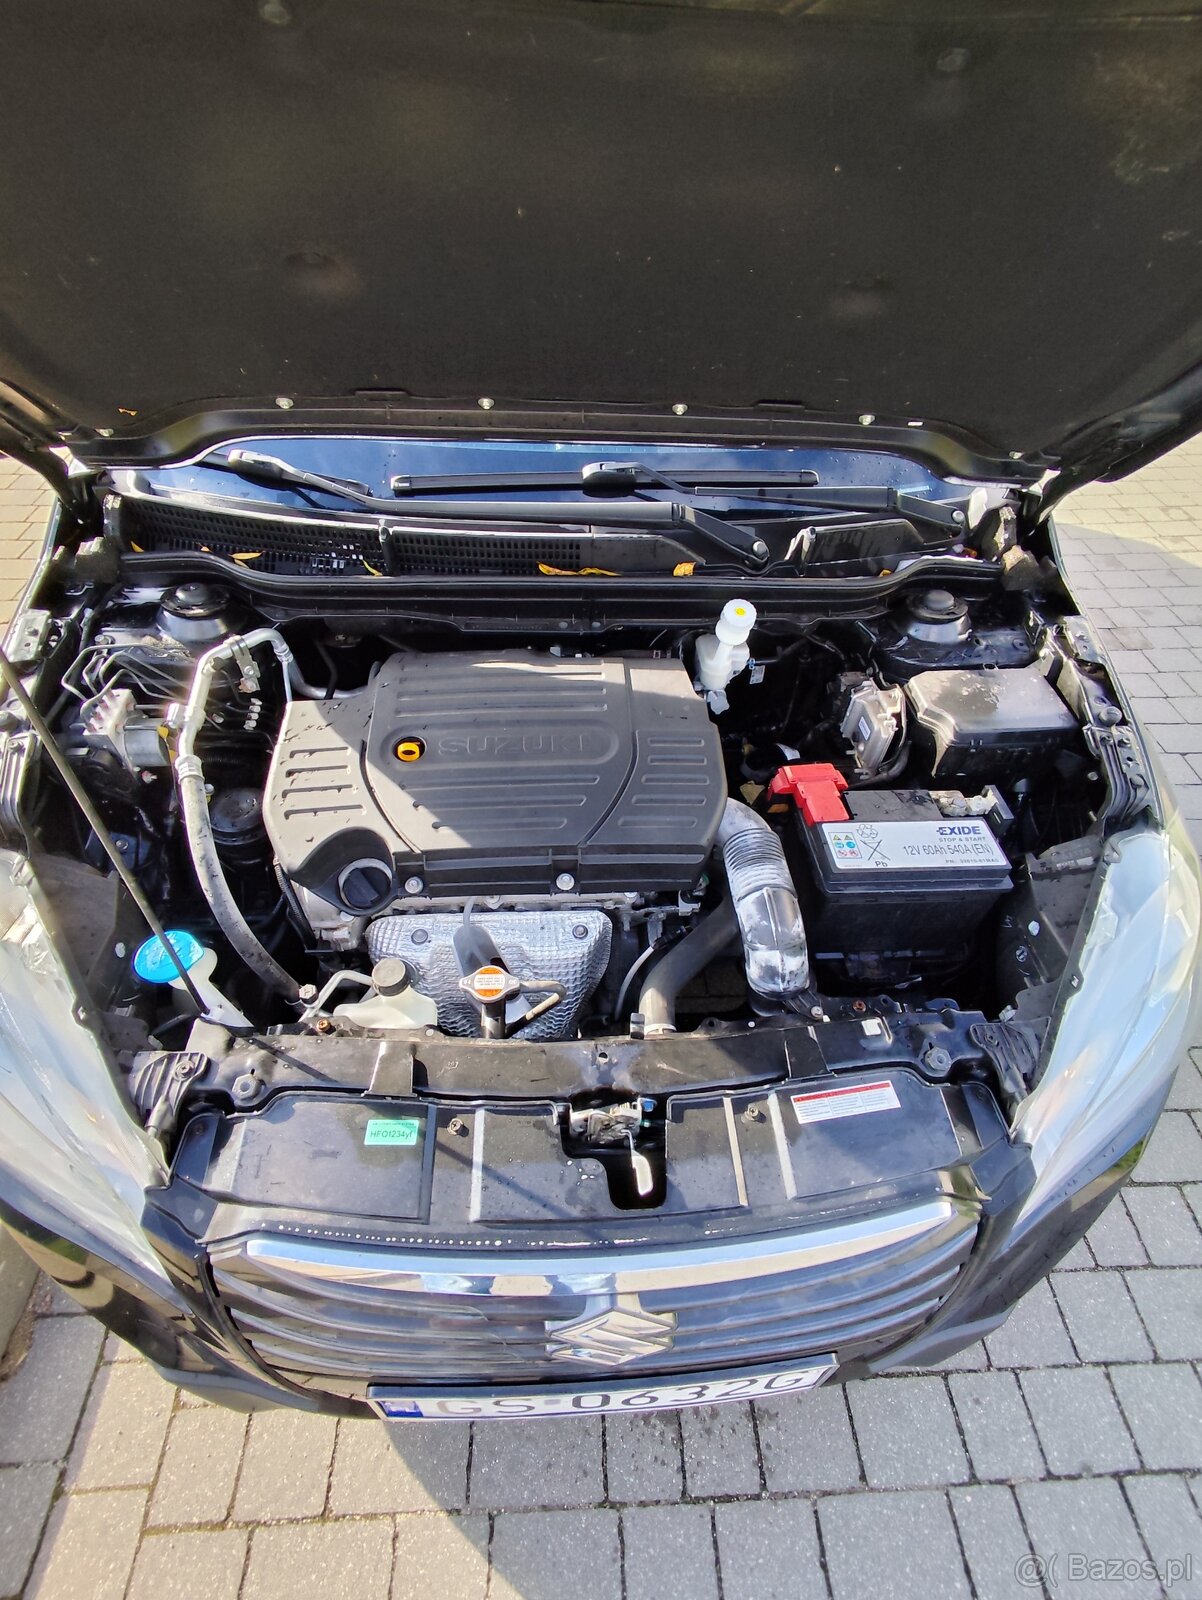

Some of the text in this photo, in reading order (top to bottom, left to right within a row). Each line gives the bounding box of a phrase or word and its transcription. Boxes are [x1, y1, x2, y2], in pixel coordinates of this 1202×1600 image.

[438, 734, 588, 756] SUZUKI
[936, 826, 982, 836] EXIDE
[903, 843, 993, 856] 12V 60Ah 540A (EN)
[875, 860, 888, 868] Pb
[370, 1130, 412, 1139] HFO1234yf
[436, 1373, 805, 1415] GS 0632G
